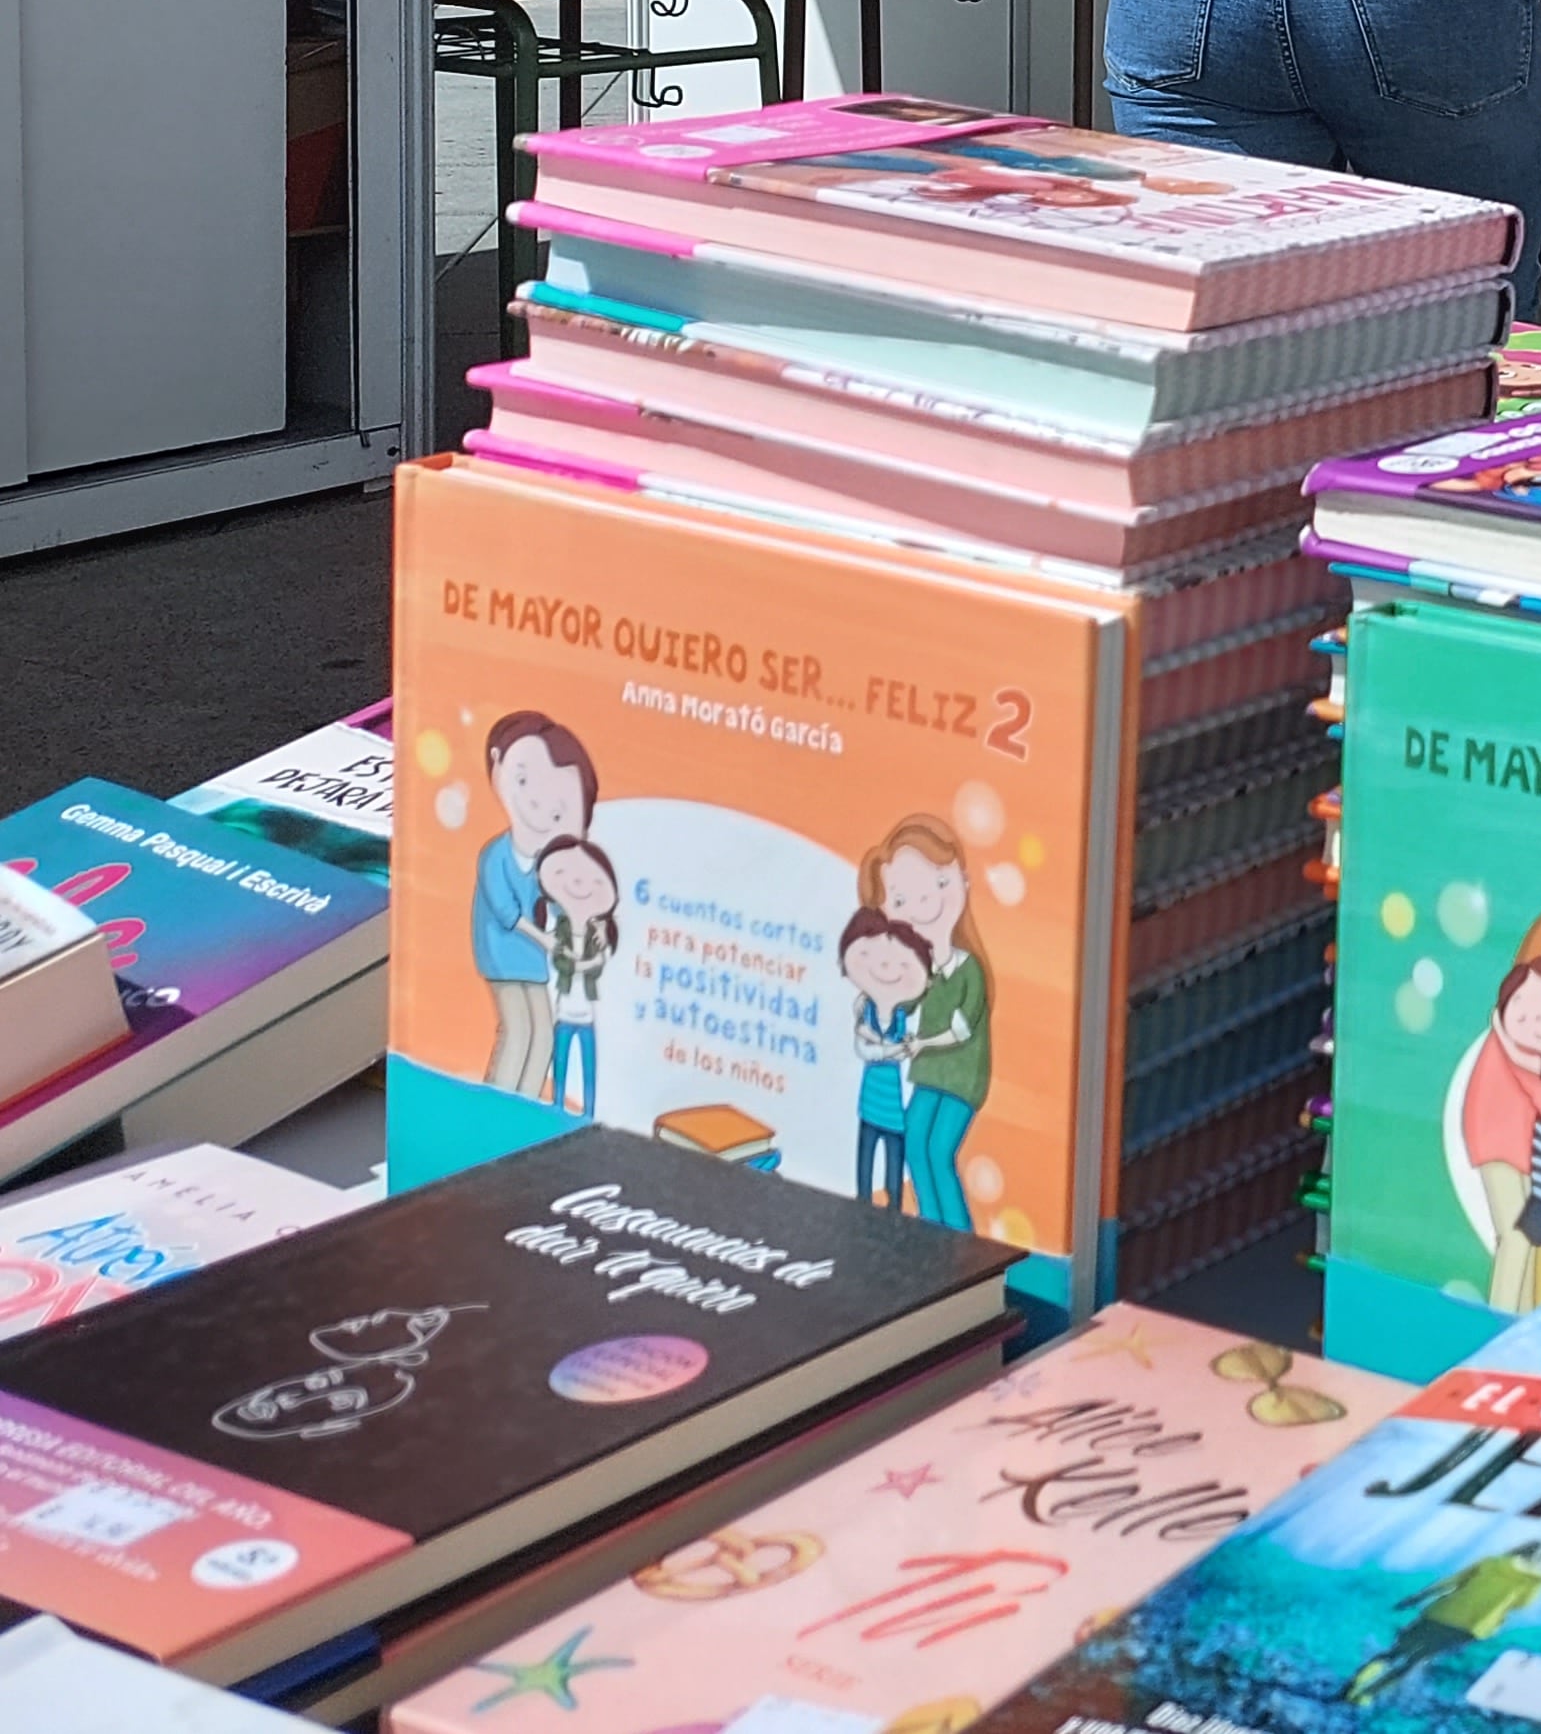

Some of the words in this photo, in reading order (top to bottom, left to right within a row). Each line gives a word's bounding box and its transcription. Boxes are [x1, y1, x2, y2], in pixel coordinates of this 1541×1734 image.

[443, 579, 478, 622] DE
[488, 589, 603, 650] MAYOR
[613, 615, 747, 684] QUIERO
[756, 650, 858, 716] SER...
[866, 676, 978, 739] FELIZ
[985, 688, 1033, 762] 2
[621, 679, 676, 715] Anna
[680, 688, 766, 737] Morató
[769, 711, 844, 756] García
[1403, 725, 1450, 776] DE
[60, 802, 145, 845] Gemma
[144, 830, 231, 880] Pasqual
[634, 878, 651, 905] 6
[658, 893, 743, 931] cuentos
[749, 918, 823, 953] cortos
[647, 926, 695, 953] para
[702, 940, 807, 983] potenciar
[634, 955, 652, 979] la
[659, 963, 820, 1026] positividad
[635, 1001, 646, 1020] y
[654, 997, 818, 1064] autoestima
[664, 1039, 686, 1063] de
[693, 1046, 723, 1075] los
[731, 1061, 785, 1094] niños
[122, 1170, 256, 1223] AMELIA
[773, 1258, 835, 1289] de
[956, 1398, 1202, 1455] Alice
[1461, 1381, 1528, 1415] EL
[979, 1456, 1250, 1541] Kelle
